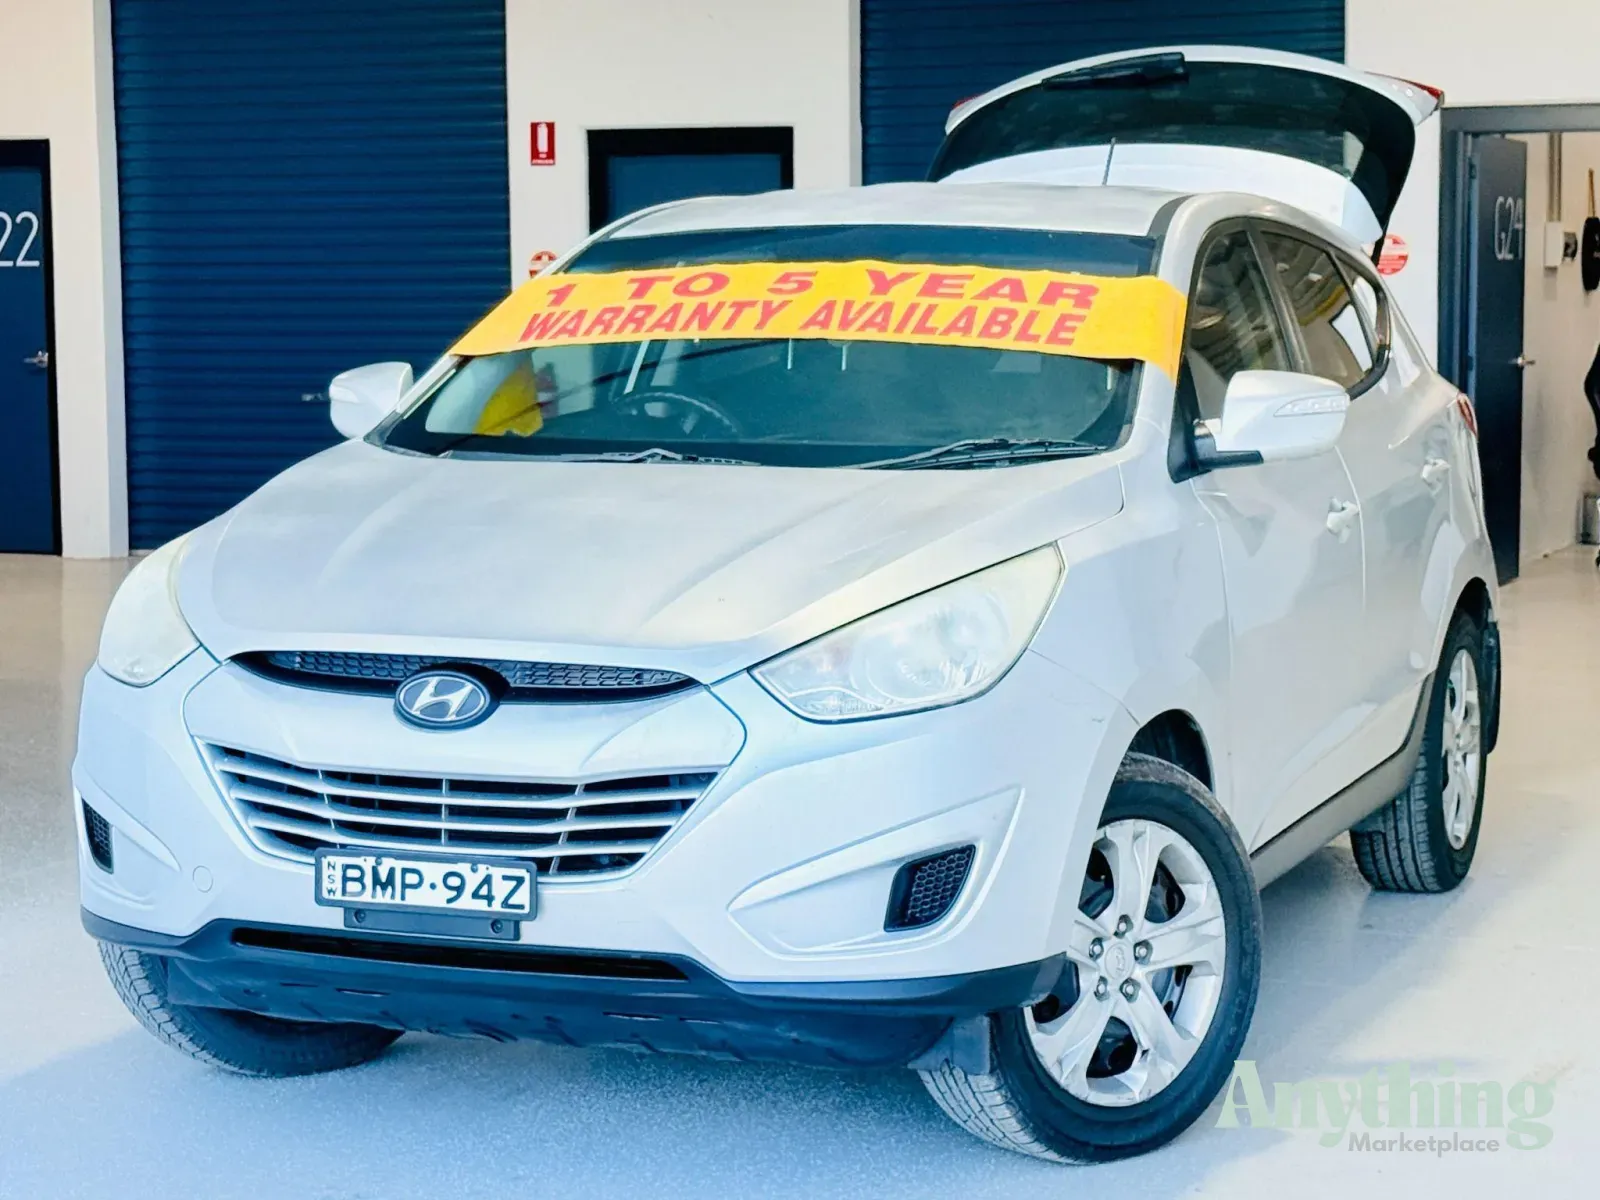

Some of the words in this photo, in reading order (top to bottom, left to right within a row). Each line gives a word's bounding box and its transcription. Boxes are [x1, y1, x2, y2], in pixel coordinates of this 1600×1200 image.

[546, 283, 580, 307] 1
[627, 272, 730, 300] TO
[766, 271, 818, 296] 5
[866, 269, 1100, 309] YEAR
[518, 300, 793, 342] WARRANTY
[799, 299, 1087, 346] AVAILABLE
